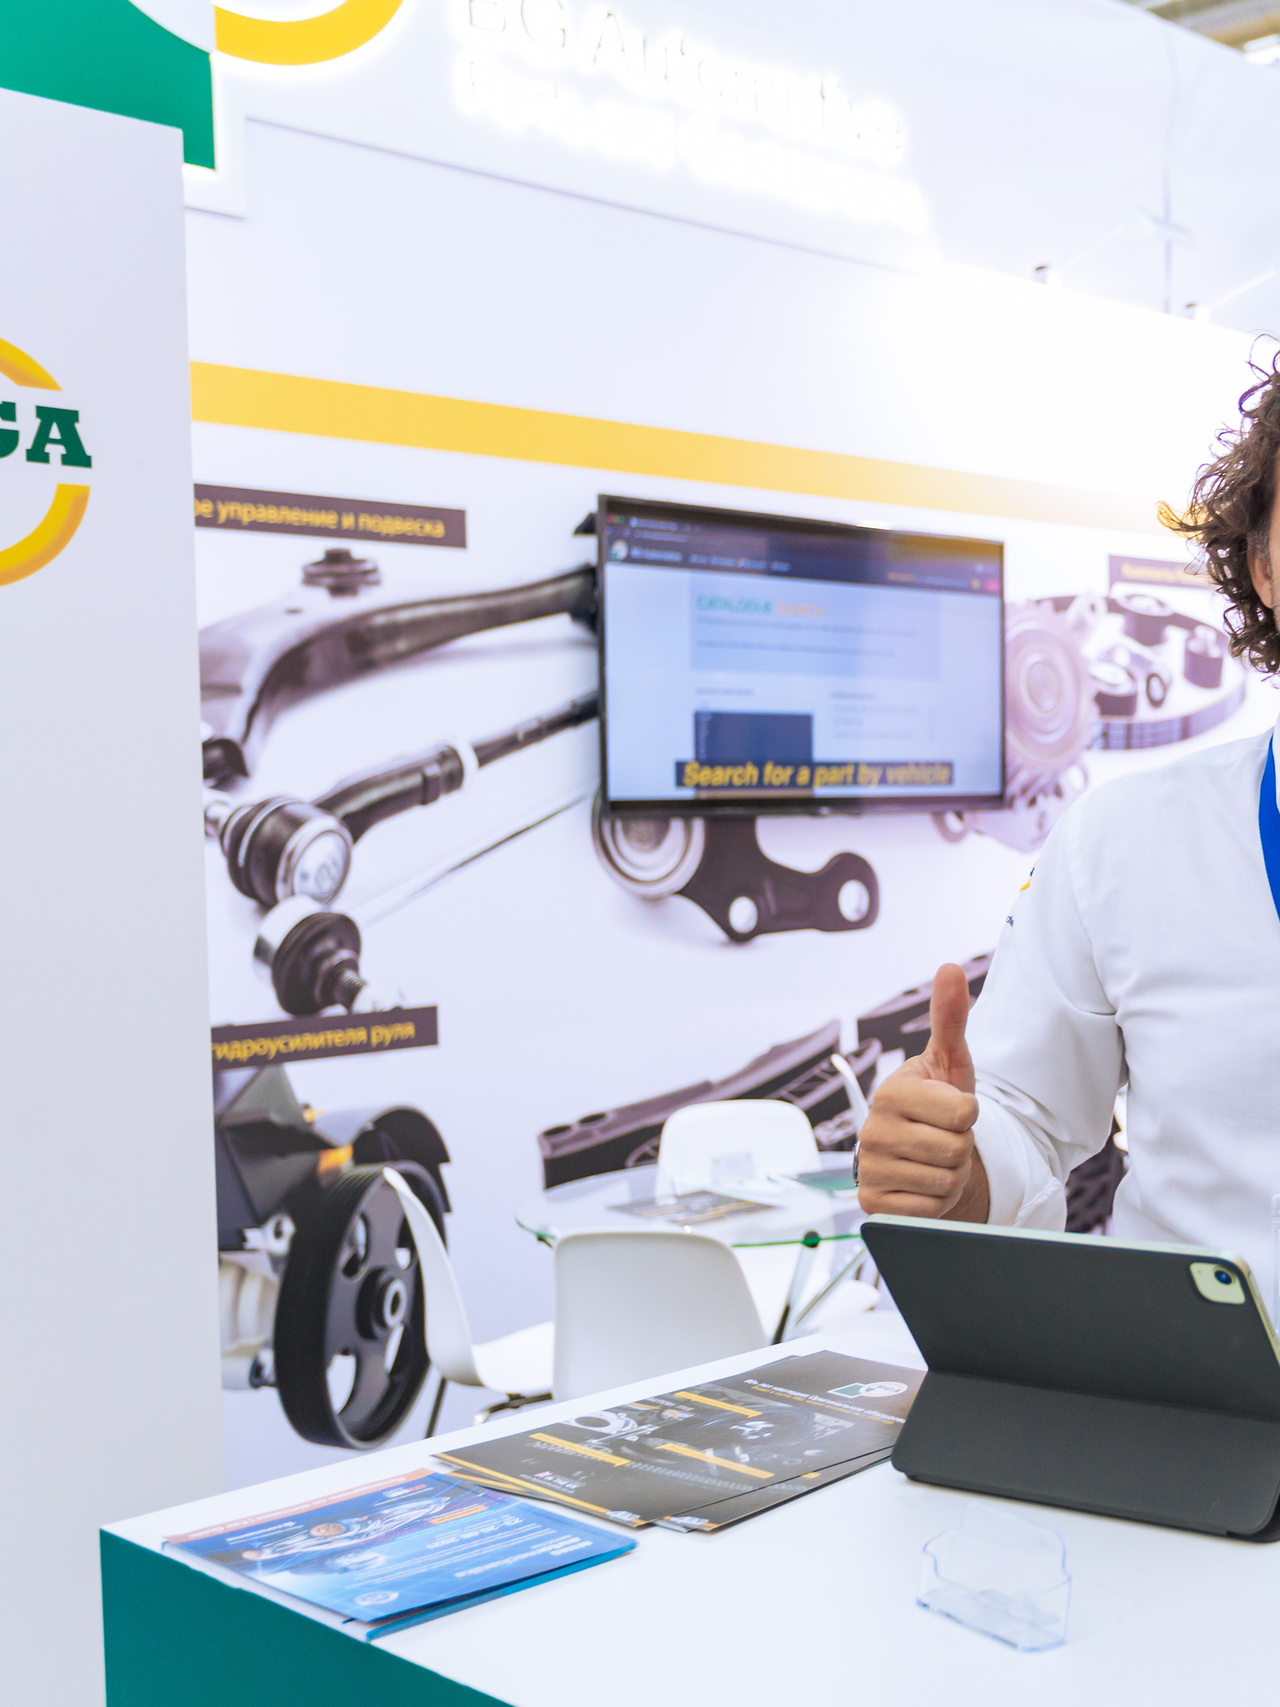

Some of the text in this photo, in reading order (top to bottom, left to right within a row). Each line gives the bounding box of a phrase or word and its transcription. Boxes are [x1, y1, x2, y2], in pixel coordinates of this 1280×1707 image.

[217, 501, 340, 529] управление
[341, 511, 355, 530] и
[358, 513, 446, 539] подвеска
[683, 760, 950, 788] Search for a part by vehicle
[371, 1022, 415, 1048] руля
